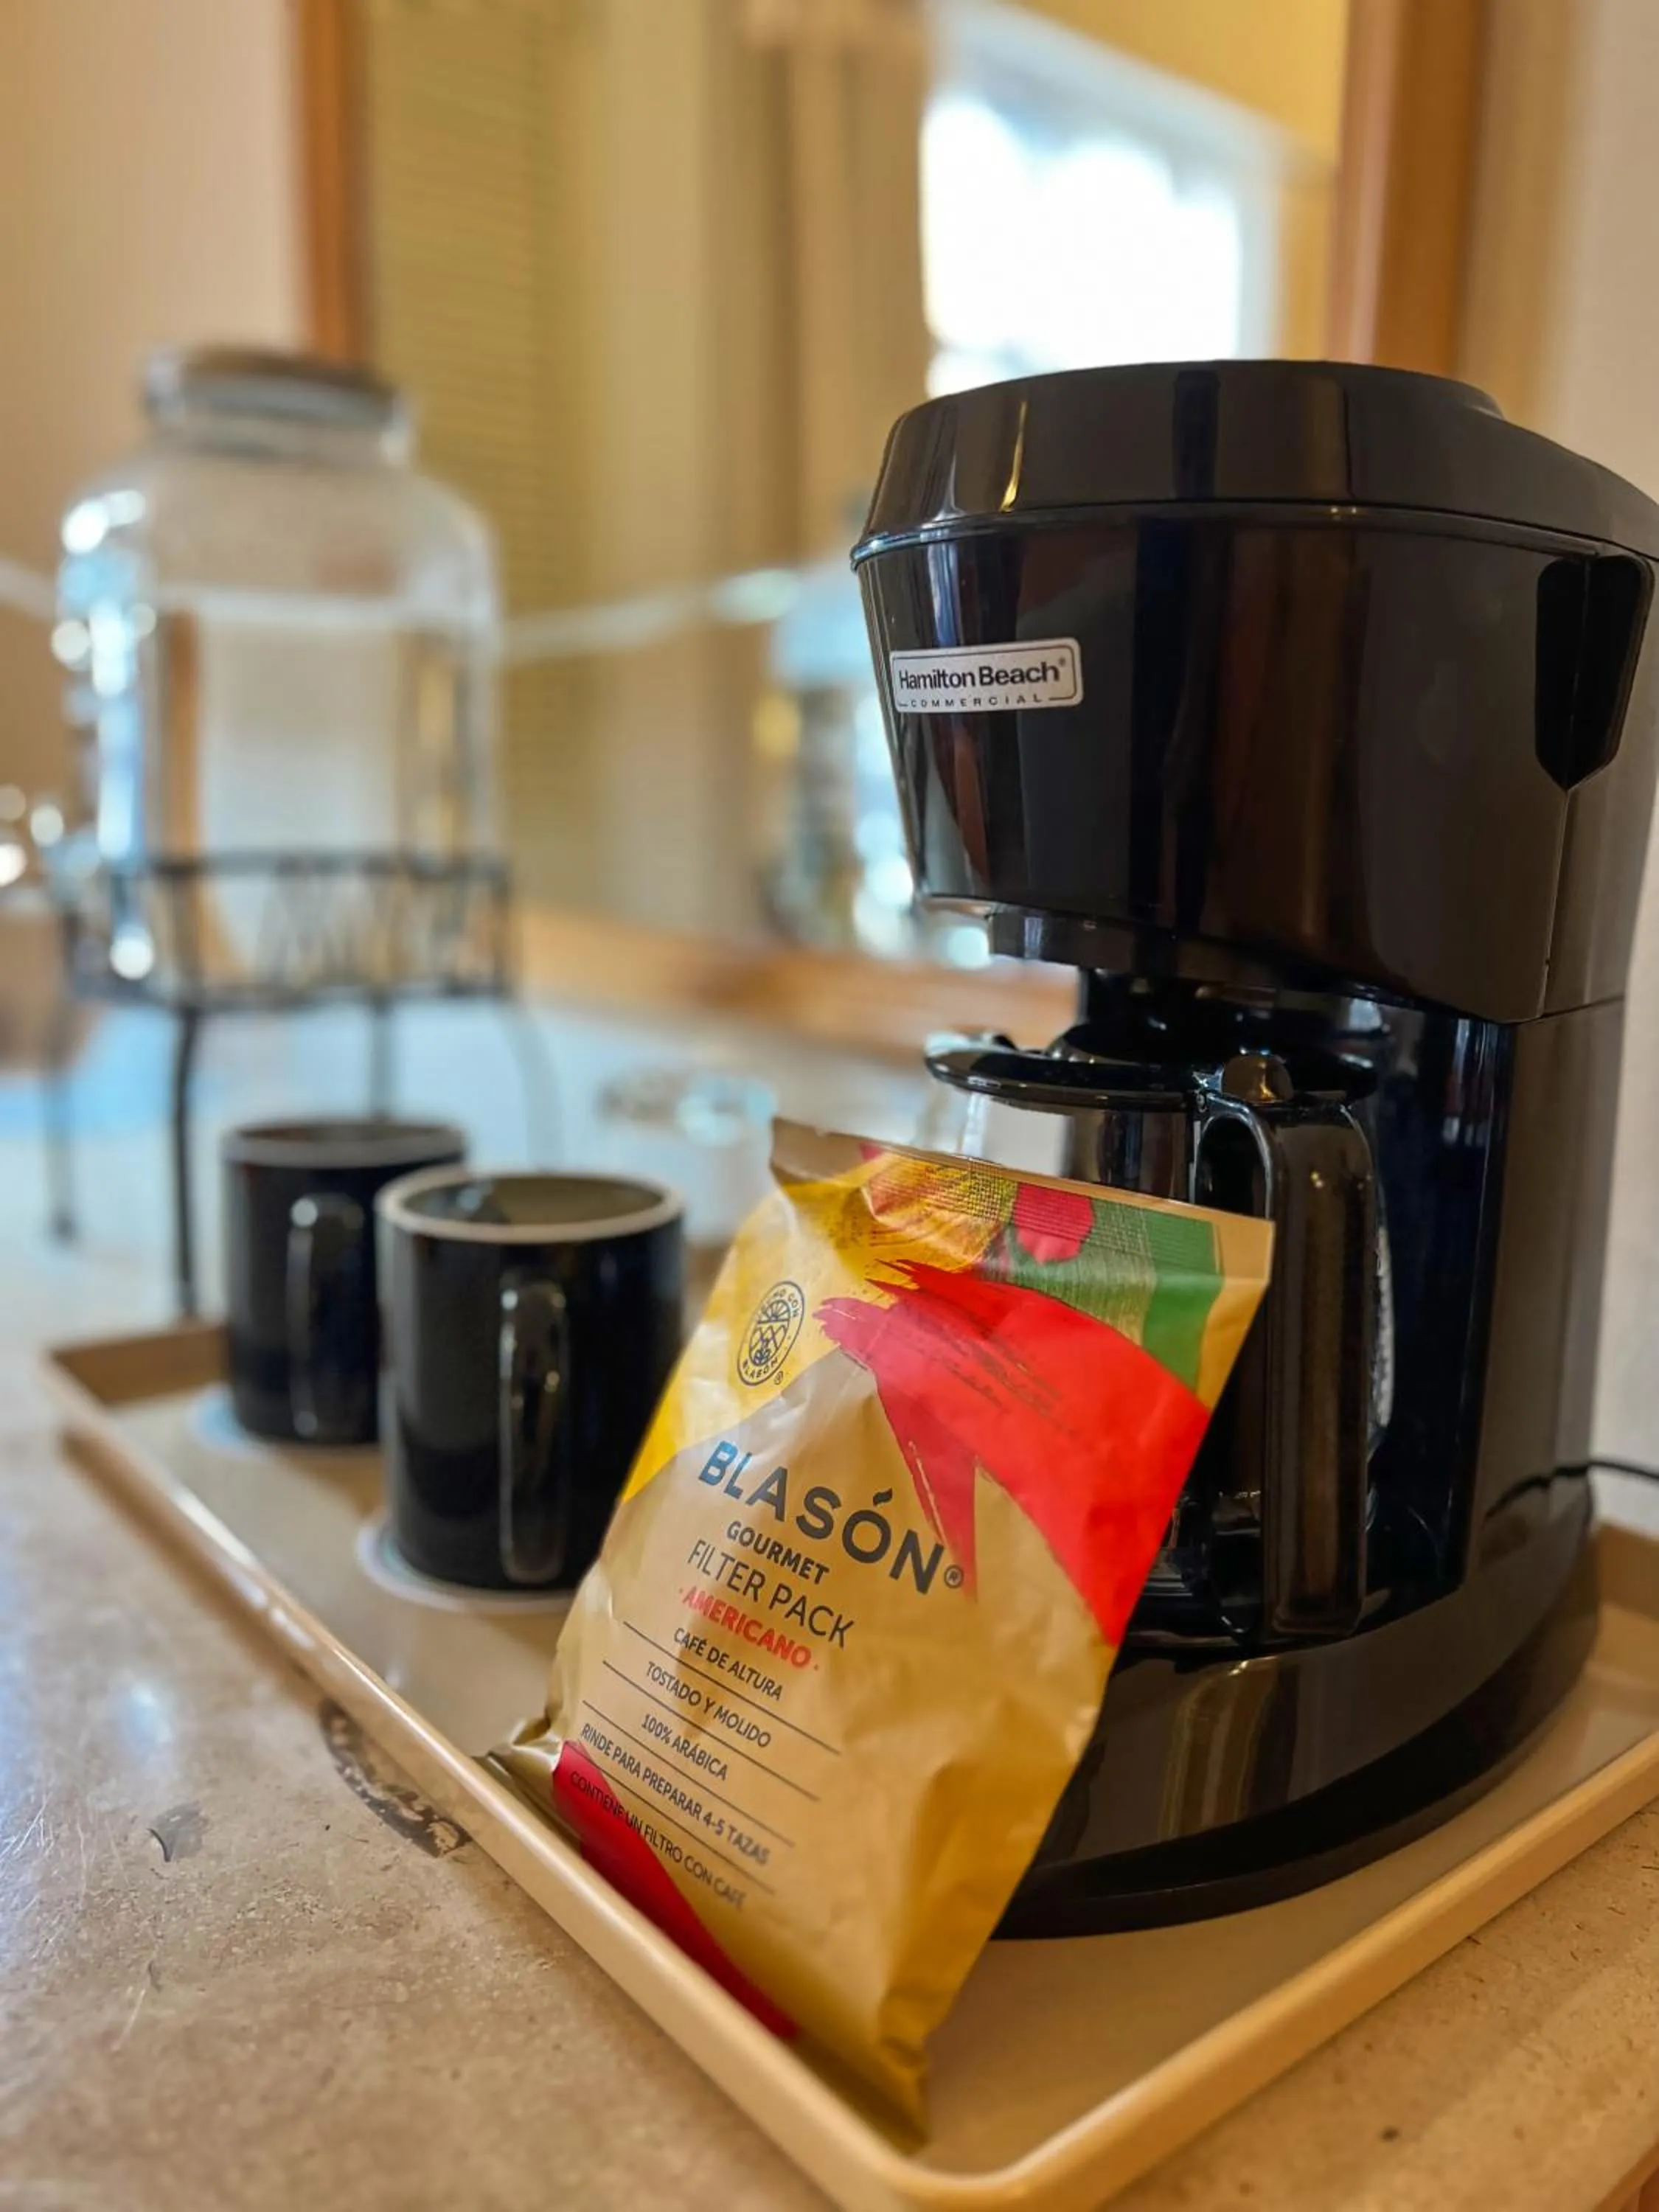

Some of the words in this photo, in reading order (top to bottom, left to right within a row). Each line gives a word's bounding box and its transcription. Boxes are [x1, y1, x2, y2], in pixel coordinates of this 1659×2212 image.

[899, 669, 975, 689] Hamilton
[911, 694, 1043, 708] COMMERCIAL
[727, 1520, 830, 1585] GOURMET
[682, 1585, 813, 1670] AMERICANO
[687, 1539, 766, 1602] FILTER
[768, 1583, 855, 1649] PACK
[673, 1627, 708, 1658] CAFÉ
[708, 1648, 729, 1669] DE
[727, 1661, 784, 1701] ALTURA
[645, 1661, 703, 1708] TOSTADO
[703, 1697, 716, 1712] Y
[714, 1705, 772, 1749] MOLIDO
[641, 1713, 672, 1745] 100%
[671, 1733, 728, 1781] ARÁBICA
[569, 1770, 626, 1821] CONTIENE
[625, 1812, 644, 1834] UN
[644, 1824, 683, 1864] FILTRO
[684, 1854, 714, 1886] CON
[580, 1722, 613, 1757] RINDE
[611, 1746, 641, 1778] PARA
[641, 1768, 703, 1820] PREPARAR
[703, 1810, 726, 1837] 4-5
[726, 1824, 771, 1867] TAZAS
